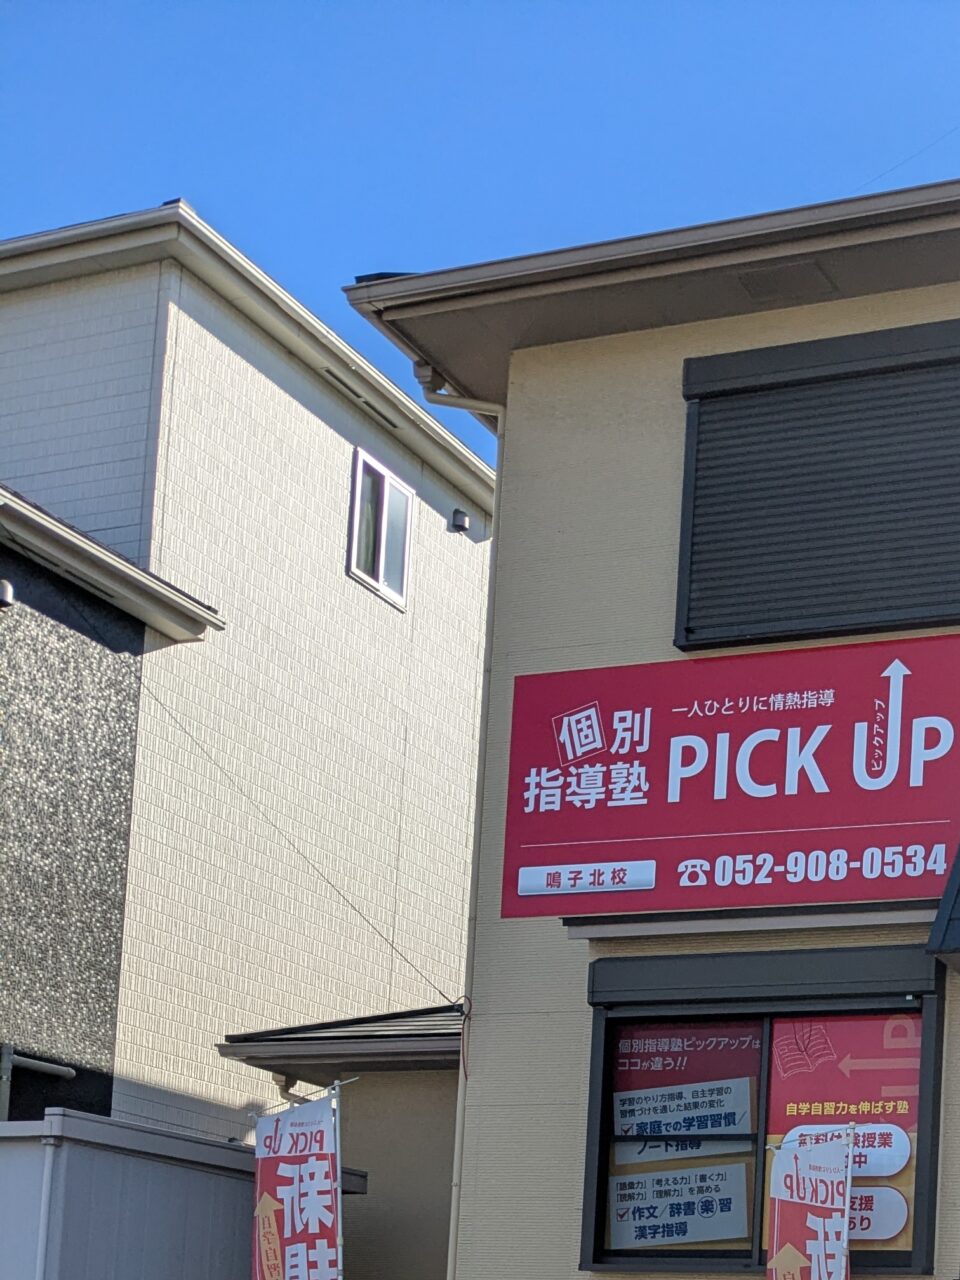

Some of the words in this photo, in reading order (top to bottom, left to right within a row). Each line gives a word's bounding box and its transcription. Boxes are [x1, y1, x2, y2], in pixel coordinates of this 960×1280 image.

[671, 689, 835, 718] 一人ひとりに情熱指導
[558, 707, 652, 760] 個別
[667, 725, 833, 803] PICK
[853, 658, 955, 791] UP
[871, 699, 885, 771] ピックアップ
[523, 760, 649, 813] 指導塾
[546, 867, 628, 889] 鳴子北校
[714, 843, 948, 887] 052-908-0534
[618, 1035, 761, 1053] 個別指導塾ピックアップは
[786, 1102, 909, 1116] 自学自習力を伸ばす塾
[634, 1221, 688, 1241] 漢字指導
